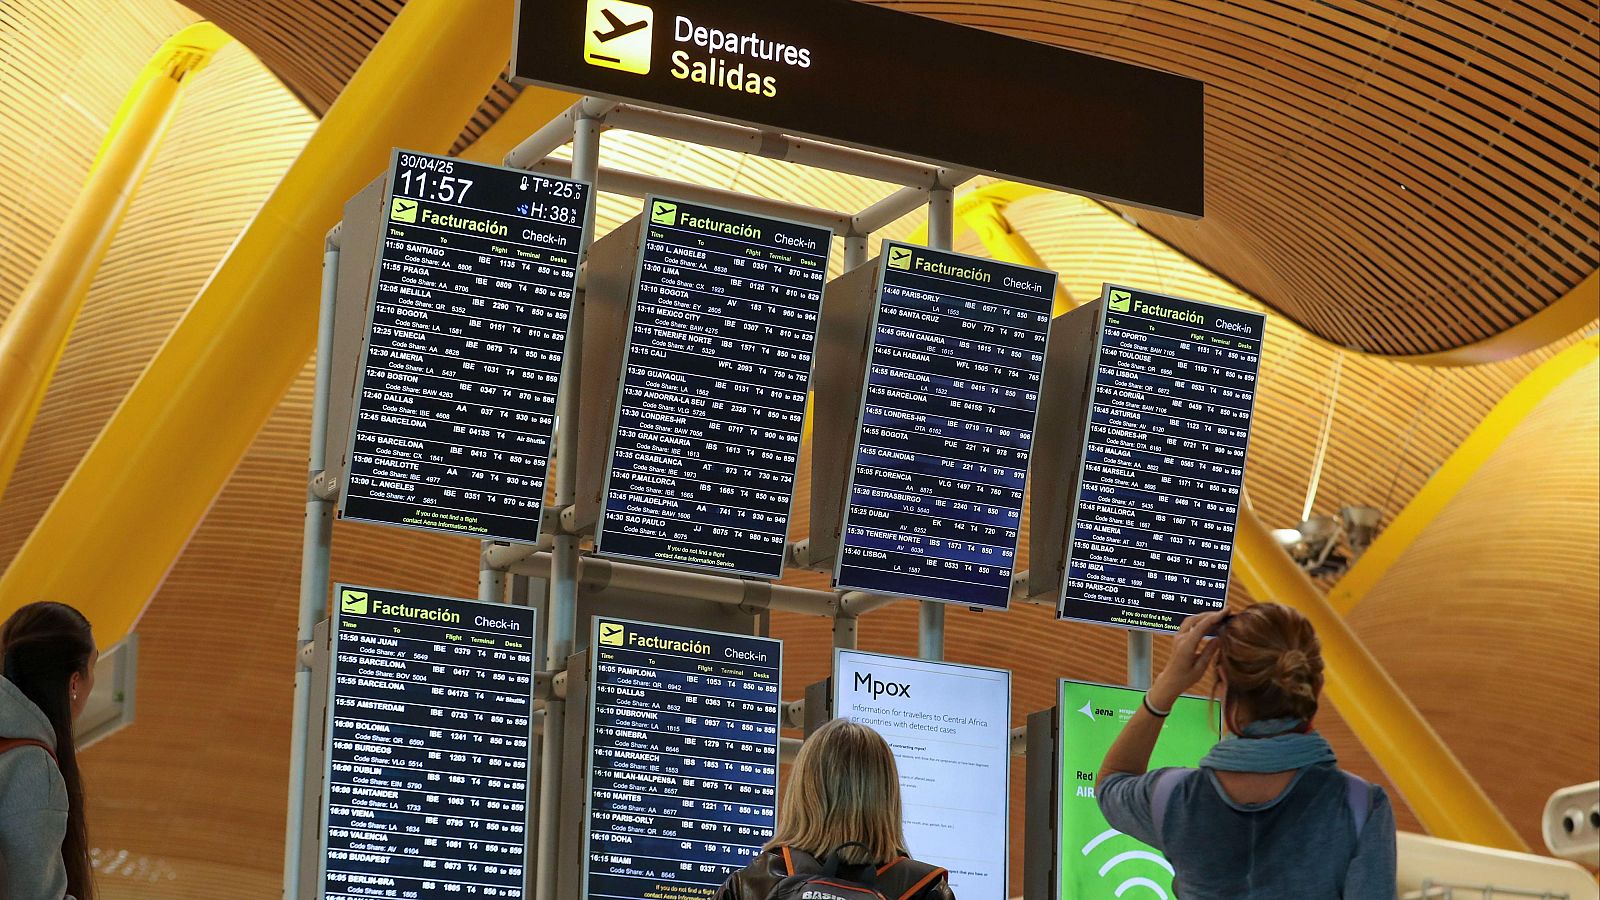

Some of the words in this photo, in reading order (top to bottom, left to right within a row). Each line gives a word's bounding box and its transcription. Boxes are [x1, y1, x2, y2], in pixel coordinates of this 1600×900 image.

[673, 15, 812, 69] Departures
[670, 50, 777, 98] Salidas
[400, 154, 454, 174] 30/04/25
[401, 169, 474, 204] 11:57
[421, 209, 507, 235] Facturación
[522, 229, 566, 245] Check-in
[680, 212, 760, 238] Facturación
[774, 233, 815, 249] Check-in
[390, 228, 404, 236] Time
[491, 245, 507, 253] Flight
[516, 249, 540, 259] Terminal
[385, 240, 404, 249] 11:50
[406, 244, 444, 256] SANTIAGO
[478, 255, 491, 264] IBE
[499, 259, 515, 268] 1135
[521, 262, 530, 270] T4
[404, 254, 420, 262] Code
[441, 260, 450, 268] AA
[646, 242, 664, 251] 13:00
[672, 247, 706, 259] ANGELES
[733, 258, 745, 266] IBE
[773, 265, 781, 273] T4
[382, 262, 401, 271] 11:55
[402, 265, 429, 276] PRAGA
[662, 266, 679, 275] LIMA
[915, 257, 990, 282] Facturación
[1003, 276, 1041, 292] Check-in
[379, 283, 398, 292] 12:05
[399, 287, 431, 298] MELILLA
[659, 287, 688, 298] BOGOTA
[883, 286, 900, 295] 14:40
[901, 289, 939, 302] PARIS-ORLY
[376, 305, 395, 313] 12:10
[396, 308, 427, 319] BOGOTA
[656, 308, 683, 318] MEXICO
[684, 313, 700, 321] CITY
[1134, 300, 1203, 324] Facturación
[1215, 318, 1251, 333] Check-in
[898, 309, 920, 319] SANTA
[921, 313, 939, 322] CRUZ
[961, 320, 976, 329] BOV
[983, 324, 994, 332] 773
[999, 327, 1007, 335] T4
[372, 326, 391, 335] 12:25
[393, 330, 425, 340] VENECIA
[653, 328, 687, 340] TENERIFE
[688, 334, 712, 344] NORTE
[895, 329, 914, 338] GRAN
[915, 333, 944, 344] CANARIA
[1121, 331, 1147, 341] OPORTO
[369, 348, 388, 356] 12:30
[389, 351, 423, 362] ALMERIA
[650, 349, 666, 357] CALI
[892, 349, 901, 357] LA
[902, 351, 930, 361] HABANA
[1118, 350, 1151, 362] TOULOUSE
[366, 369, 385, 378] 12:40
[386, 372, 418, 383] BOSTON
[647, 370, 686, 382] GUAYAQUIL
[889, 369, 930, 382] BARCELONA
[1115, 370, 1138, 379] LISBOA
[363, 391, 382, 399] 12:40
[383, 394, 413, 404] DALLAS
[1118, 389, 1144, 400] CORUÑA
[359, 412, 379, 420] 12:45
[380, 415, 426, 427] BARCELONA
[640, 411, 686, 424] LONDRES-HR
[883, 409, 926, 422] LONDRES-HR
[1109, 408, 1140, 419] ASTURIAS
[637, 432, 658, 441] GRAN
[659, 435, 690, 446] CANARIA
[880, 429, 908, 440] BOGOTA
[1107, 427, 1147, 440] LONDRES-HR
[356, 434, 375, 442] 12:45
[377, 436, 423, 449] BARCELONA
[1104, 447, 1131, 457] MALAGA
[353, 455, 372, 463] 13:00
[374, 458, 418, 470] CHARLOTTE
[634, 453, 682, 466] CASABLANCA
[874, 469, 911, 481] FLORENCIA
[1101, 466, 1135, 477] MARSELLA
[350, 476, 369, 485] 13:00
[378, 480, 414, 491] ANGELES
[1099, 485, 1114, 493] VIGO
[628, 494, 678, 507] PHILADELPHIA
[871, 489, 921, 502] ESTRASBURGO
[868, 509, 889, 518] DUBAI
[625, 515, 640, 523] SAO
[641, 517, 665, 526] PAULO
[1093, 524, 1120, 534] ALMERIA
[865, 529, 897, 540] TENERIFE
[898, 534, 921, 543] NORTE
[862, 549, 886, 559] LISBOA
[1090, 543, 1114, 552] BILBAO
[1087, 563, 1104, 571] IBIZA
[1085, 582, 1118, 593] PARIS-CDG
[372, 600, 459, 622] Facturación
[474, 615, 519, 630] Check-in
[339, 633, 358, 641] 15:50
[359, 635, 376, 644] SAN
[376, 638, 397, 646] JUAN
[629, 632, 710, 654] Facturación
[724, 647, 766, 661] Check-in
[358, 657, 406, 668] BARCELONA
[598, 664, 615, 672] 16:05
[617, 666, 656, 677] PAMPLONA
[686, 675, 698, 683] IBE
[706, 677, 721, 685] 1053
[616, 687, 644, 697] DALLAS
[854, 671, 911, 700] Mpox
[356, 700, 404, 712] AMSTERDAM
[1095, 708, 1114, 717] aena
[615, 708, 657, 719] DUBROVNIK
[852, 704, 890, 715] Information
[903, 711, 933, 721] travellers
[934, 714, 941, 722] to
[942, 715, 967, 724] Central
[968, 718, 988, 727] Africa
[355, 722, 390, 732] BOLONIA
[861, 717, 892, 727] countries
[894, 720, 908, 729] with
[909, 721, 938, 732] detected
[940, 726, 957, 735] cases
[615, 729, 647, 739] GINEBRA
[354, 743, 391, 754] BURDEOS
[614, 750, 659, 761] MARRAKECH
[353, 765, 382, 775] DUBLIN
[1076, 770, 1093, 781] Red
[613, 771, 676, 784] MILAN-MALPENSA
[352, 787, 398, 798] SANTANDER
[612, 792, 641, 801] NANTES
[1076, 785, 1097, 798] AIR
[350, 809, 374, 818] VIENA
[611, 813, 653, 824] PARIS-ORLY
[349, 831, 388, 841] VALENCIA
[610, 834, 632, 843] DOHA
[348, 853, 390, 863] BUDAPEST
[610, 856, 631, 864] MIAMI
